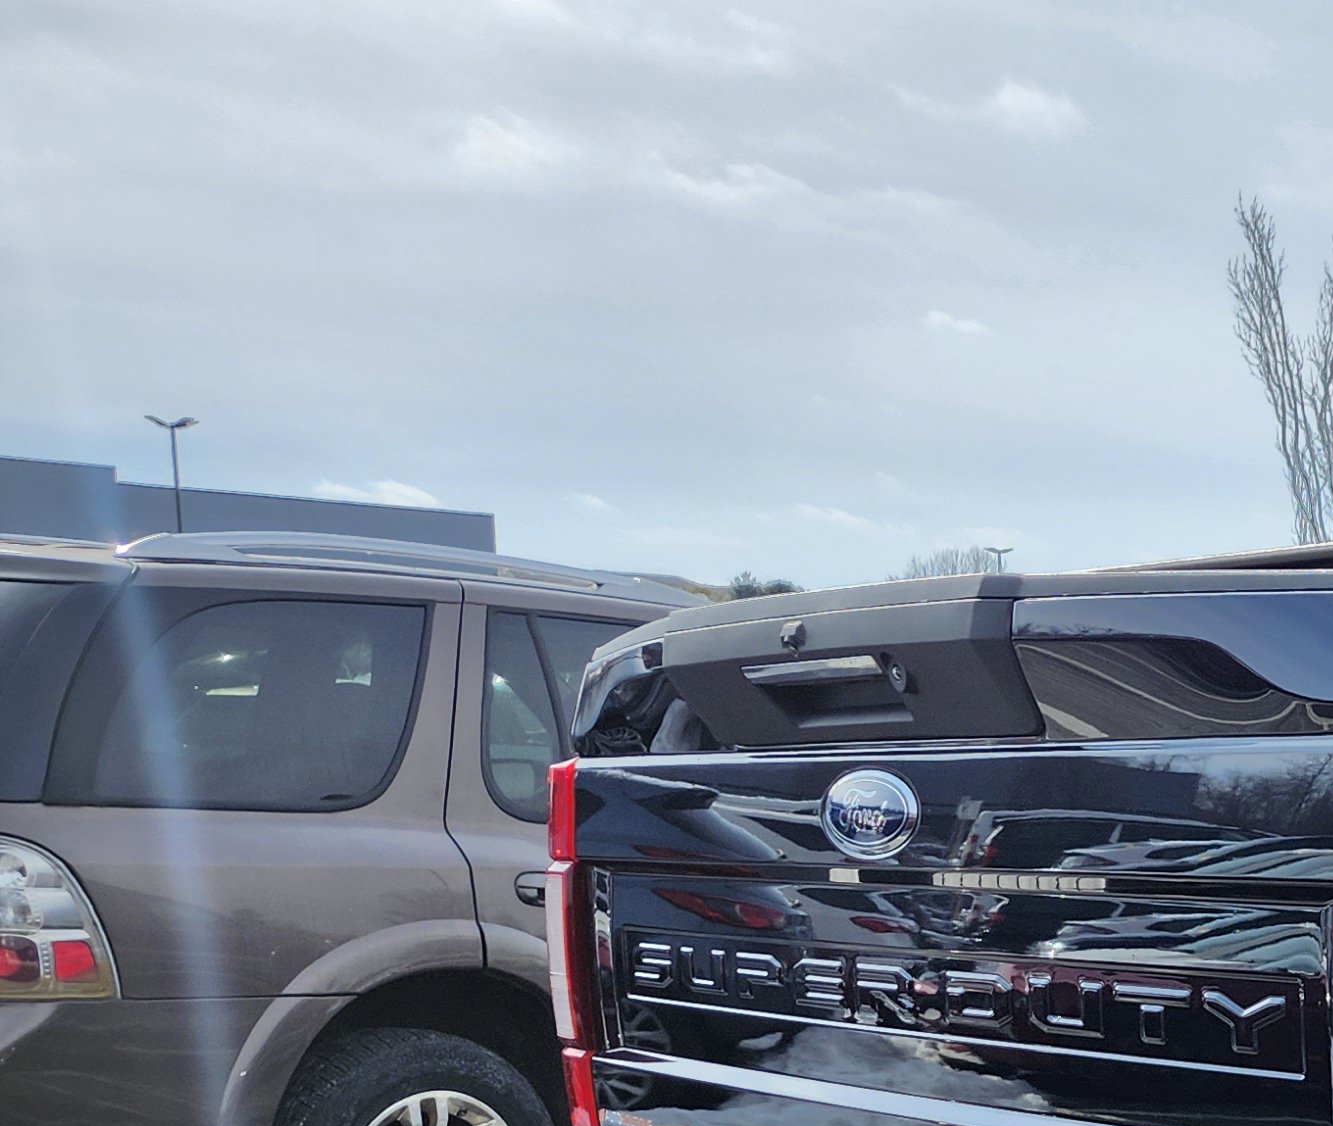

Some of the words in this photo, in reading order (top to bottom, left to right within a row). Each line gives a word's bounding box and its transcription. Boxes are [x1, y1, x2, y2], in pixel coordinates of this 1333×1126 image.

[840, 788, 888, 832] Ford
[633, 941, 917, 1026] SUPER
[944, 969, 1287, 1055] DUTY
